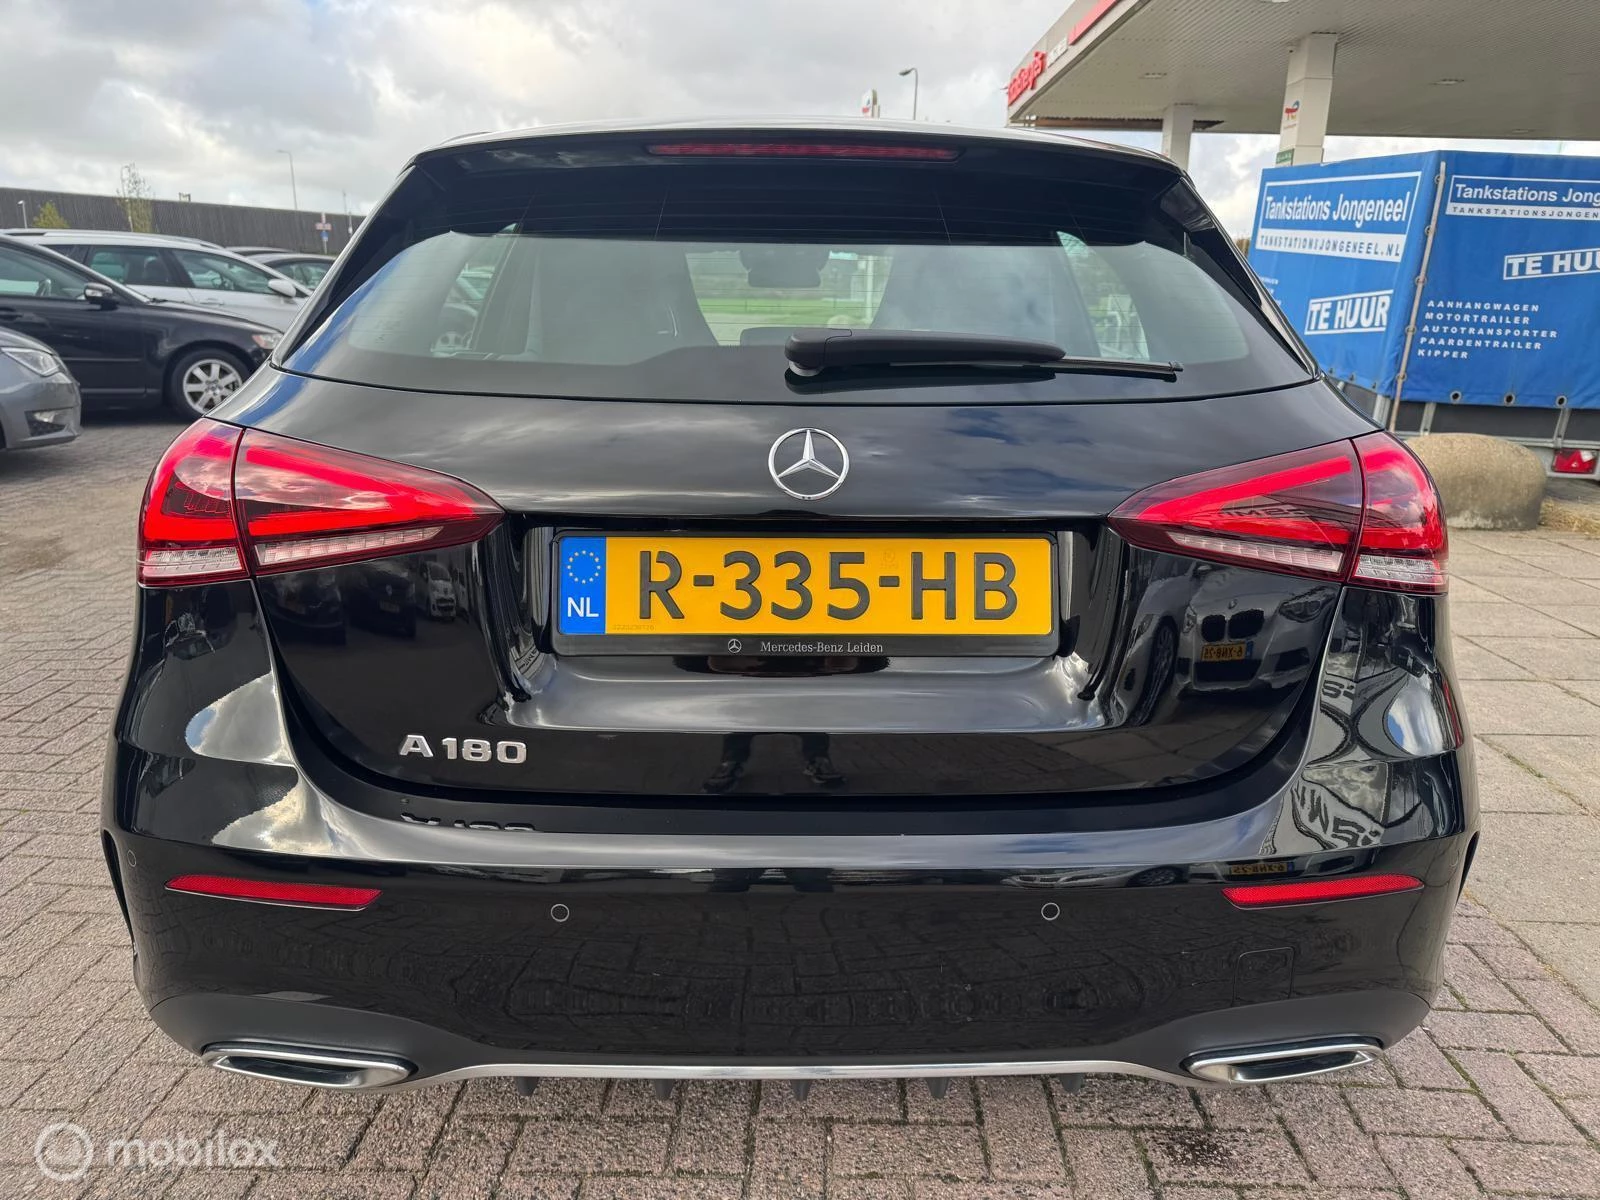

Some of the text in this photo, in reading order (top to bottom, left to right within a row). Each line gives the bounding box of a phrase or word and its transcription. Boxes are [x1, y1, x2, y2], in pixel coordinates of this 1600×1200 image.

[1455, 183, 1558, 202] Tankstations
[1265, 191, 1411, 228] Tankstations Jongeneel
[1260, 234, 1401, 257] TANKSTATIONSJONGENEEL.NL
[1507, 255, 1543, 277] TE
[1309, 295, 1391, 330] TE HUUR
[1427, 300, 1540, 312] AANHANGWAGEN
[1424, 312, 1530, 325] MOTORTRAILER
[1422, 324, 1558, 338] AUTOTRANSPORTER
[1419, 337, 1542, 350] PAARDENTRAILER
[1417, 348, 1469, 359] KIPPER
[567, 597, 599, 618] NL
[638, 550, 1018, 621] R-335-HB
[760, 641, 884, 653] Mercedes-Benz Leiden
[399, 734, 527, 764] A 180
